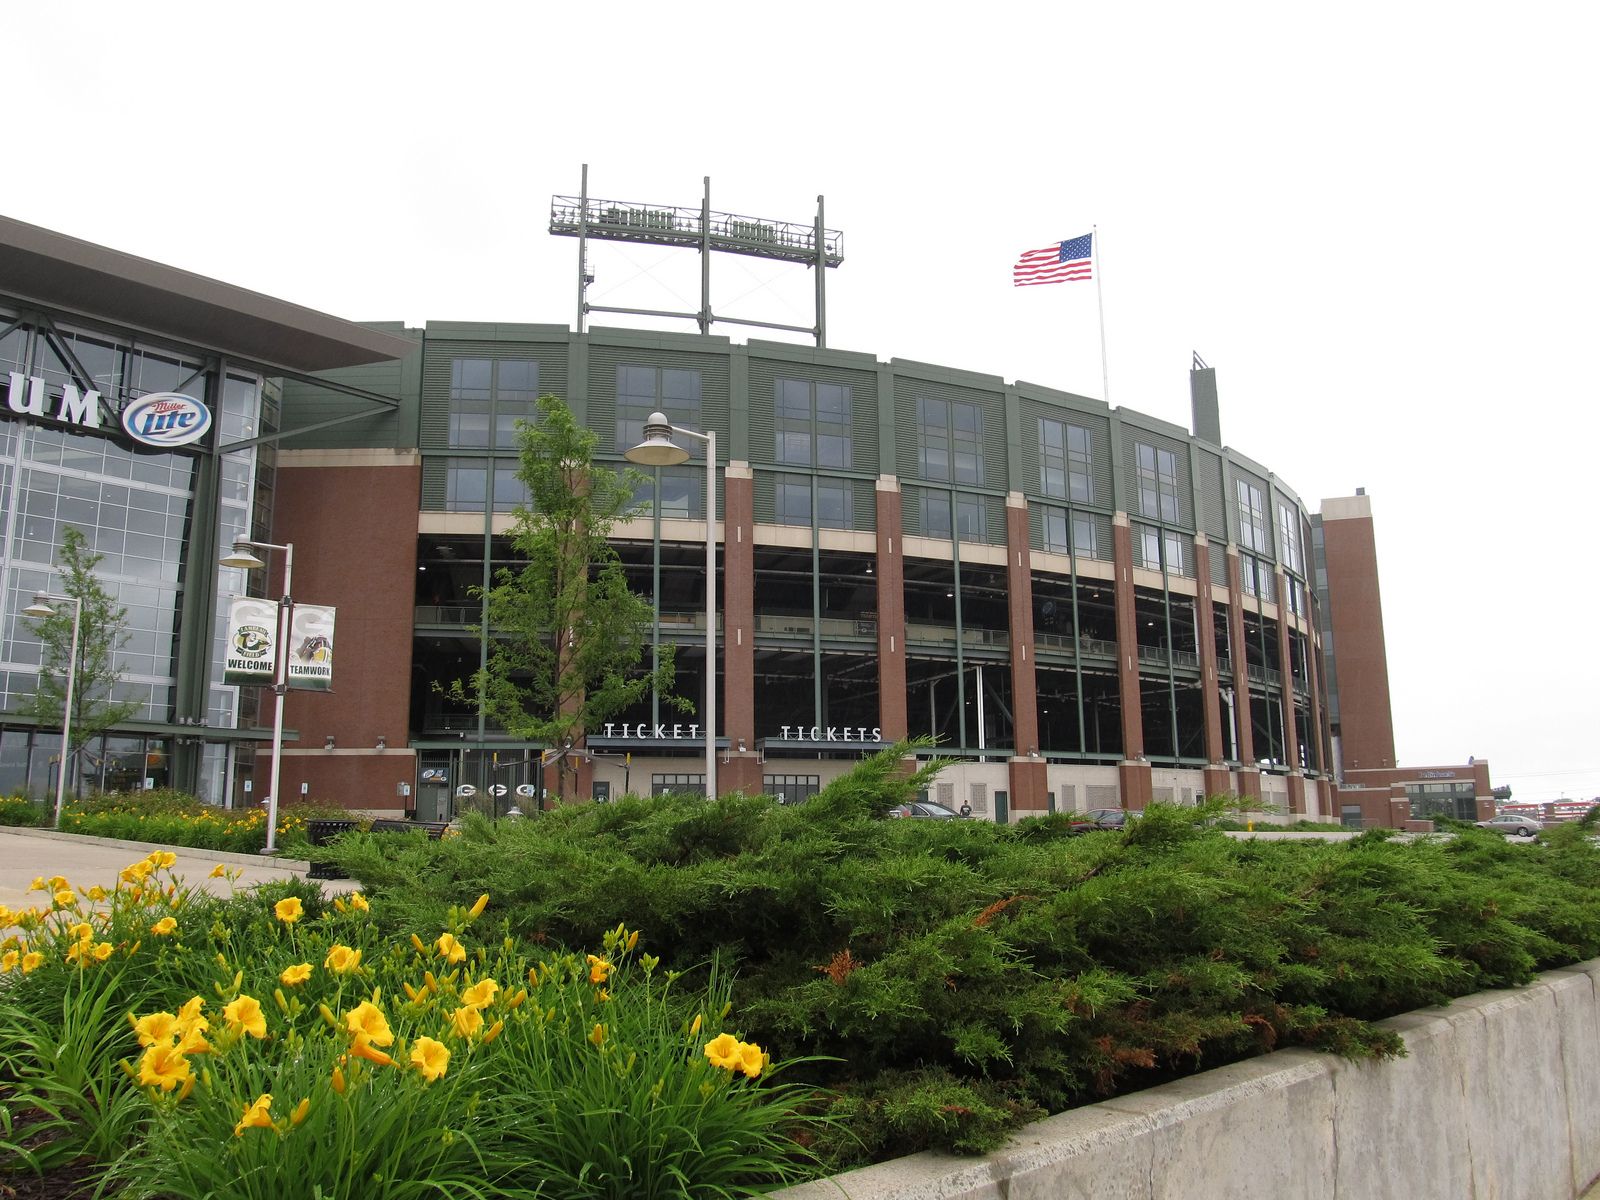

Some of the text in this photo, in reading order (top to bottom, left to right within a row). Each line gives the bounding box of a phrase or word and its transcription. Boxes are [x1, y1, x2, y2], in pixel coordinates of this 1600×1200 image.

[151, 401, 187, 412] Miller
[142, 411, 196, 435] Lite
[228, 659, 272, 671] WELCOME
[289, 665, 330, 676] TEAMWORK
[604, 723, 699, 739] TICKET
[781, 725, 881, 742] TICKETS
